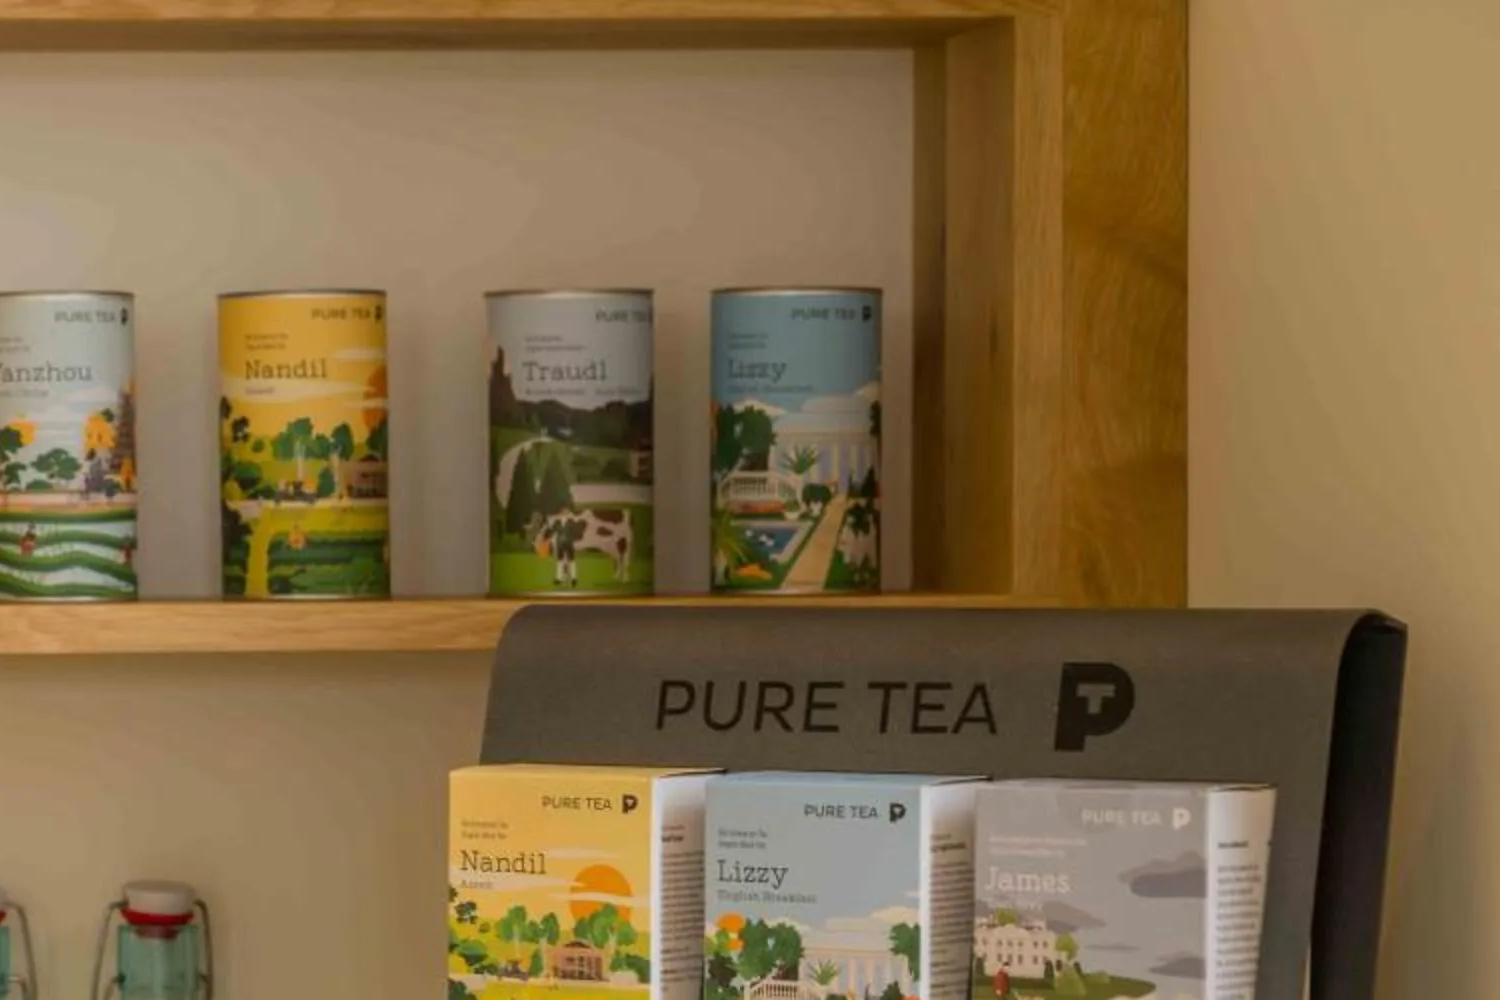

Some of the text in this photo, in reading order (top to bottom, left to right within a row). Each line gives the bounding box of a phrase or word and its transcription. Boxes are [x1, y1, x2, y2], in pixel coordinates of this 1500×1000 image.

[54, 311, 92, 323] PURE
[311, 307, 347, 320] PURE
[790, 308, 830, 321] PURE
[244, 358, 328, 381] Nandil
[521, 359, 607, 382] Traudl
[728, 358, 787, 384] Lizzy
[654, 678, 846, 734] PURE
[866, 680, 997, 735] TEA
[540, 794, 581, 811] PURE
[584, 796, 613, 812] TEA
[803, 803, 846, 819] PURE
[850, 804, 880, 819] TEA
[1080, 807, 1127, 826] PURE
[1130, 809, 1164, 827] TEA
[459, 848, 547, 876] Nandil
[716, 858, 789, 890] Lizzy
[983, 865, 1072, 895] James
